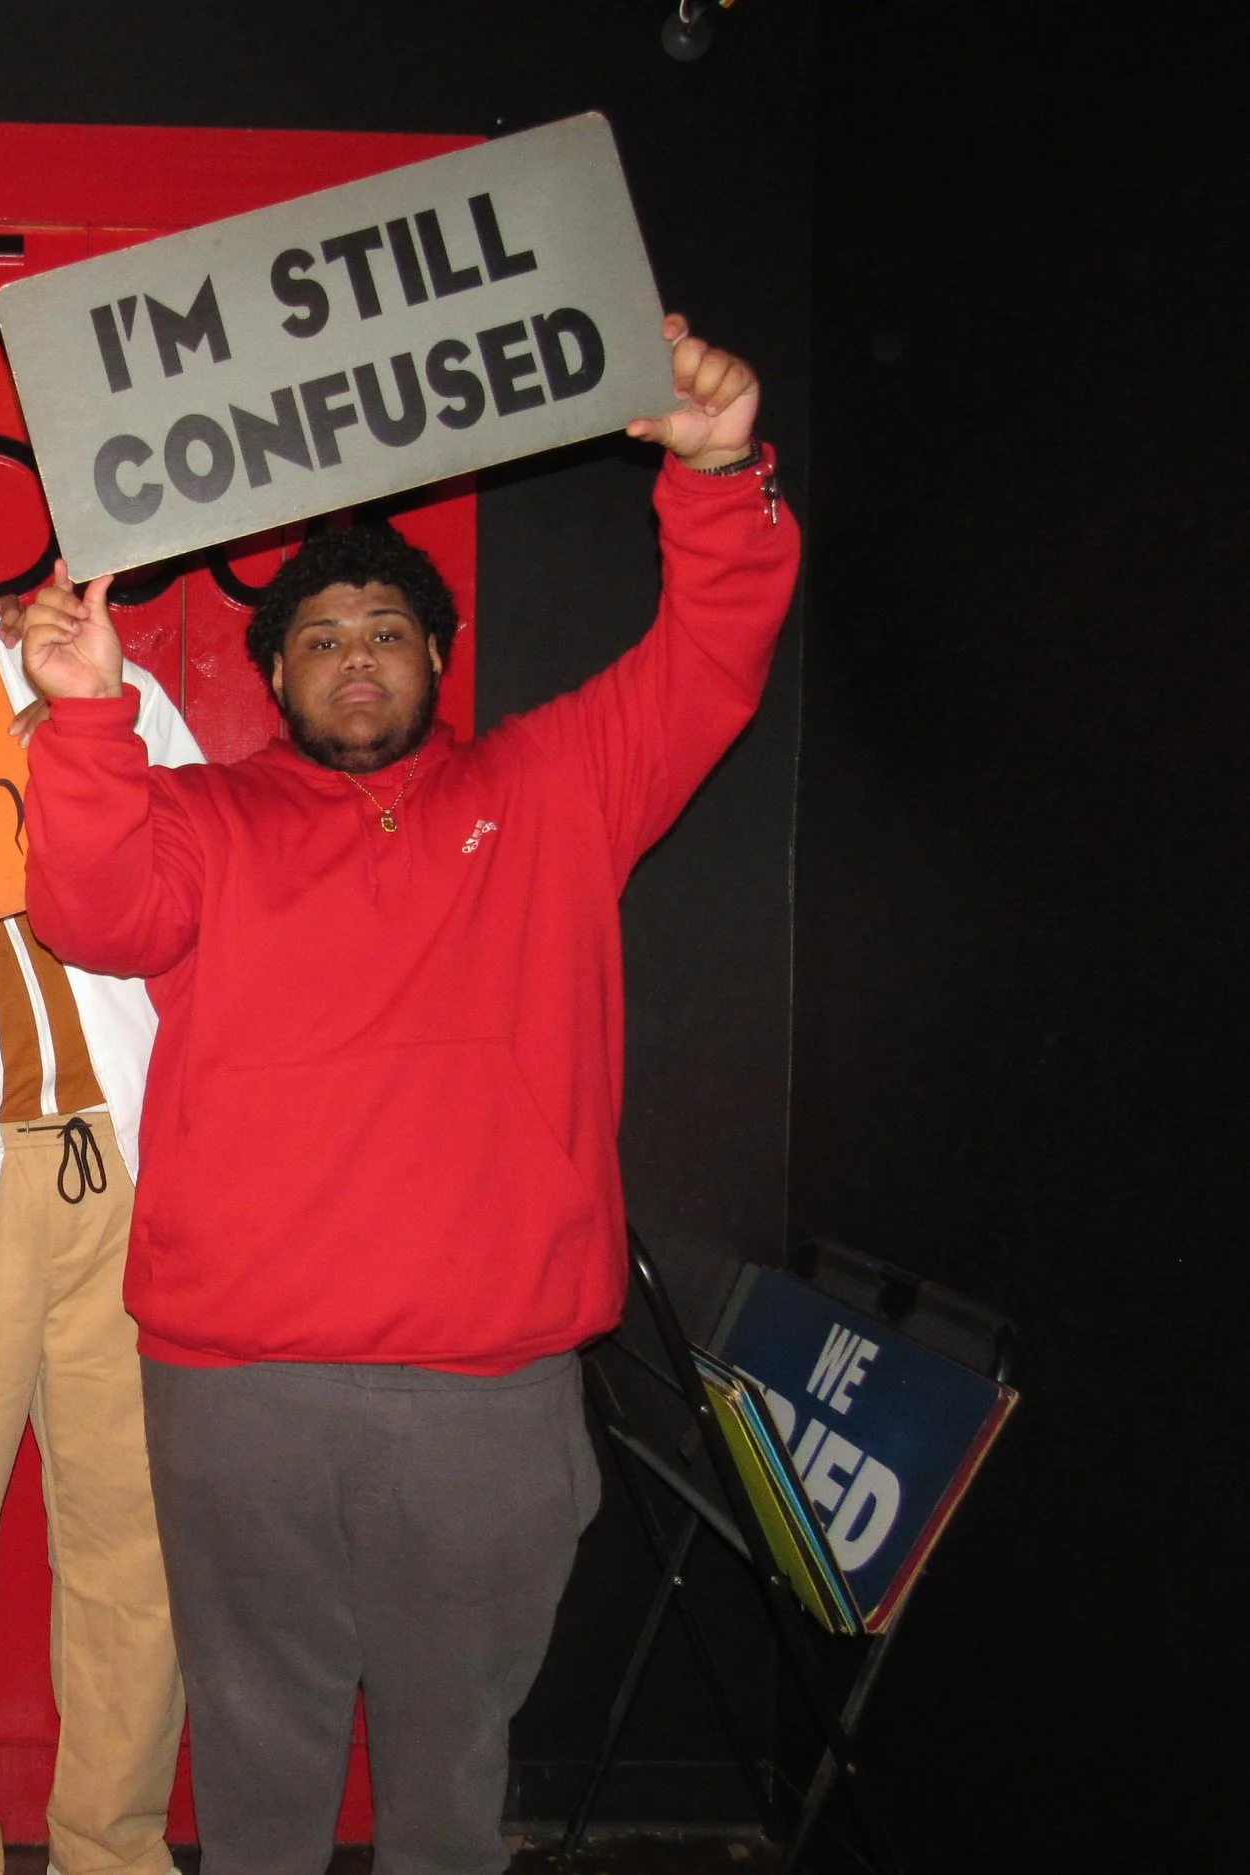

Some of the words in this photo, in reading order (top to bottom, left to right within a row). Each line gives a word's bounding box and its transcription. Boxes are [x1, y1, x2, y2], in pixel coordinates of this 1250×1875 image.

[90, 274, 232, 394] I'M
[270, 192, 538, 338] STILL
[93, 307, 605, 525] CONFUSED
[733, 1365, 900, 1571] IED
[806, 1323, 880, 1415] WE
